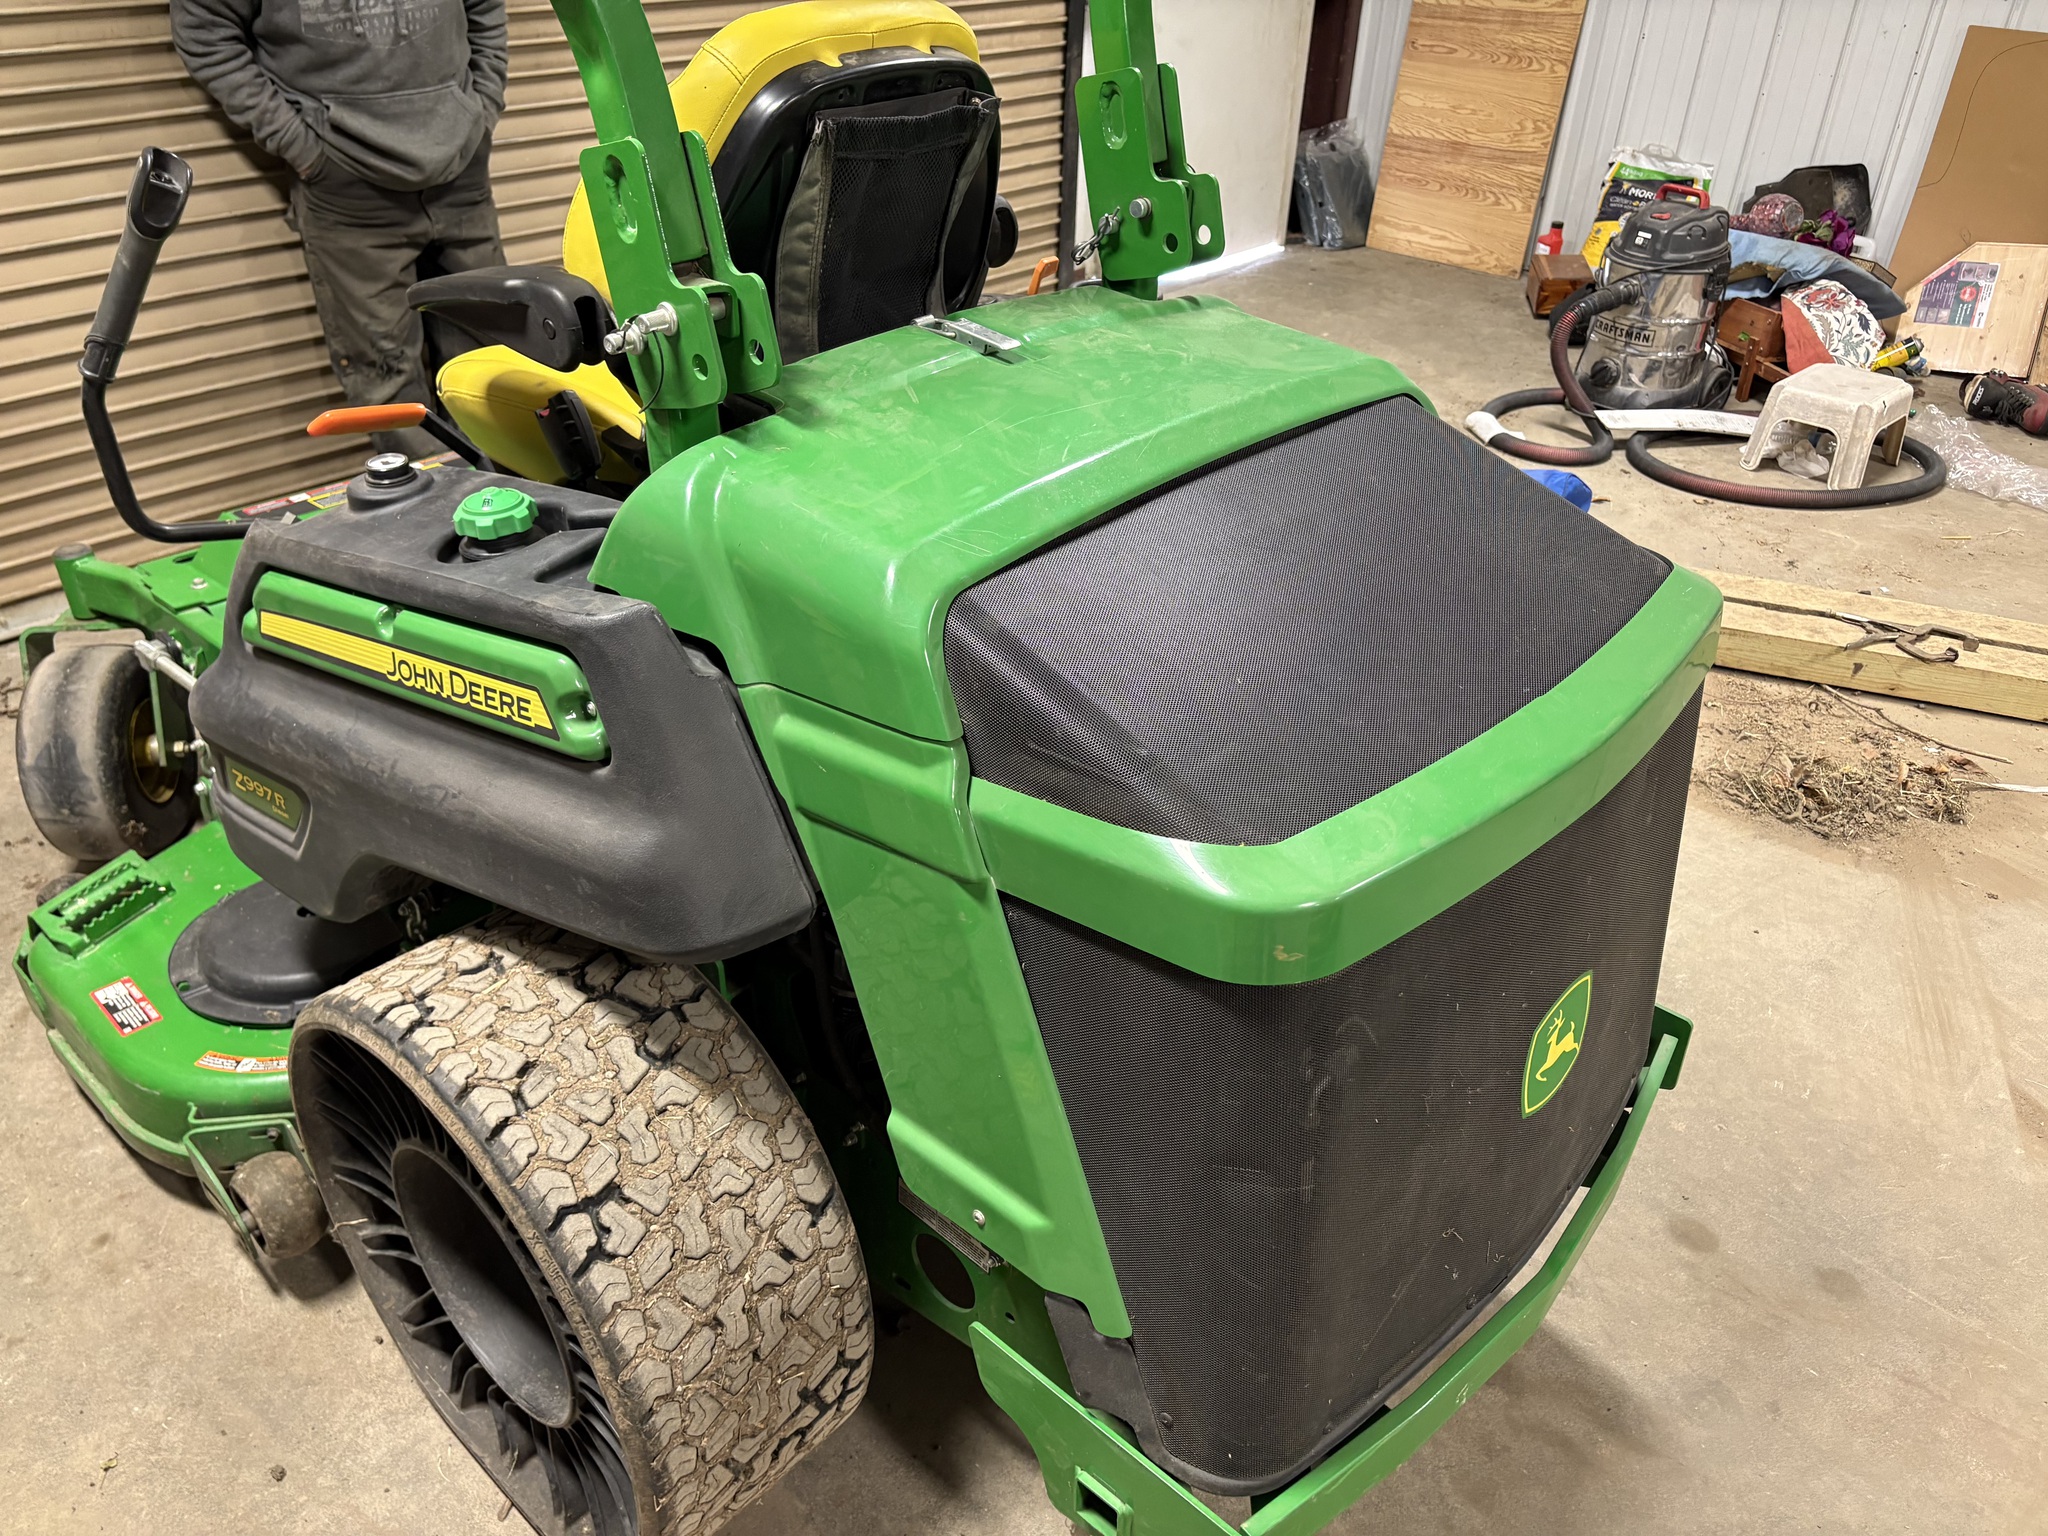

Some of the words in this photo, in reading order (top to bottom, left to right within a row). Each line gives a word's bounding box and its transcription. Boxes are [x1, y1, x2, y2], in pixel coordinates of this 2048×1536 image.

[1594, 318, 1651, 344] CRAFTSMAN
[387, 652, 444, 693] JOHN
[449, 670, 532, 722] DEERE
